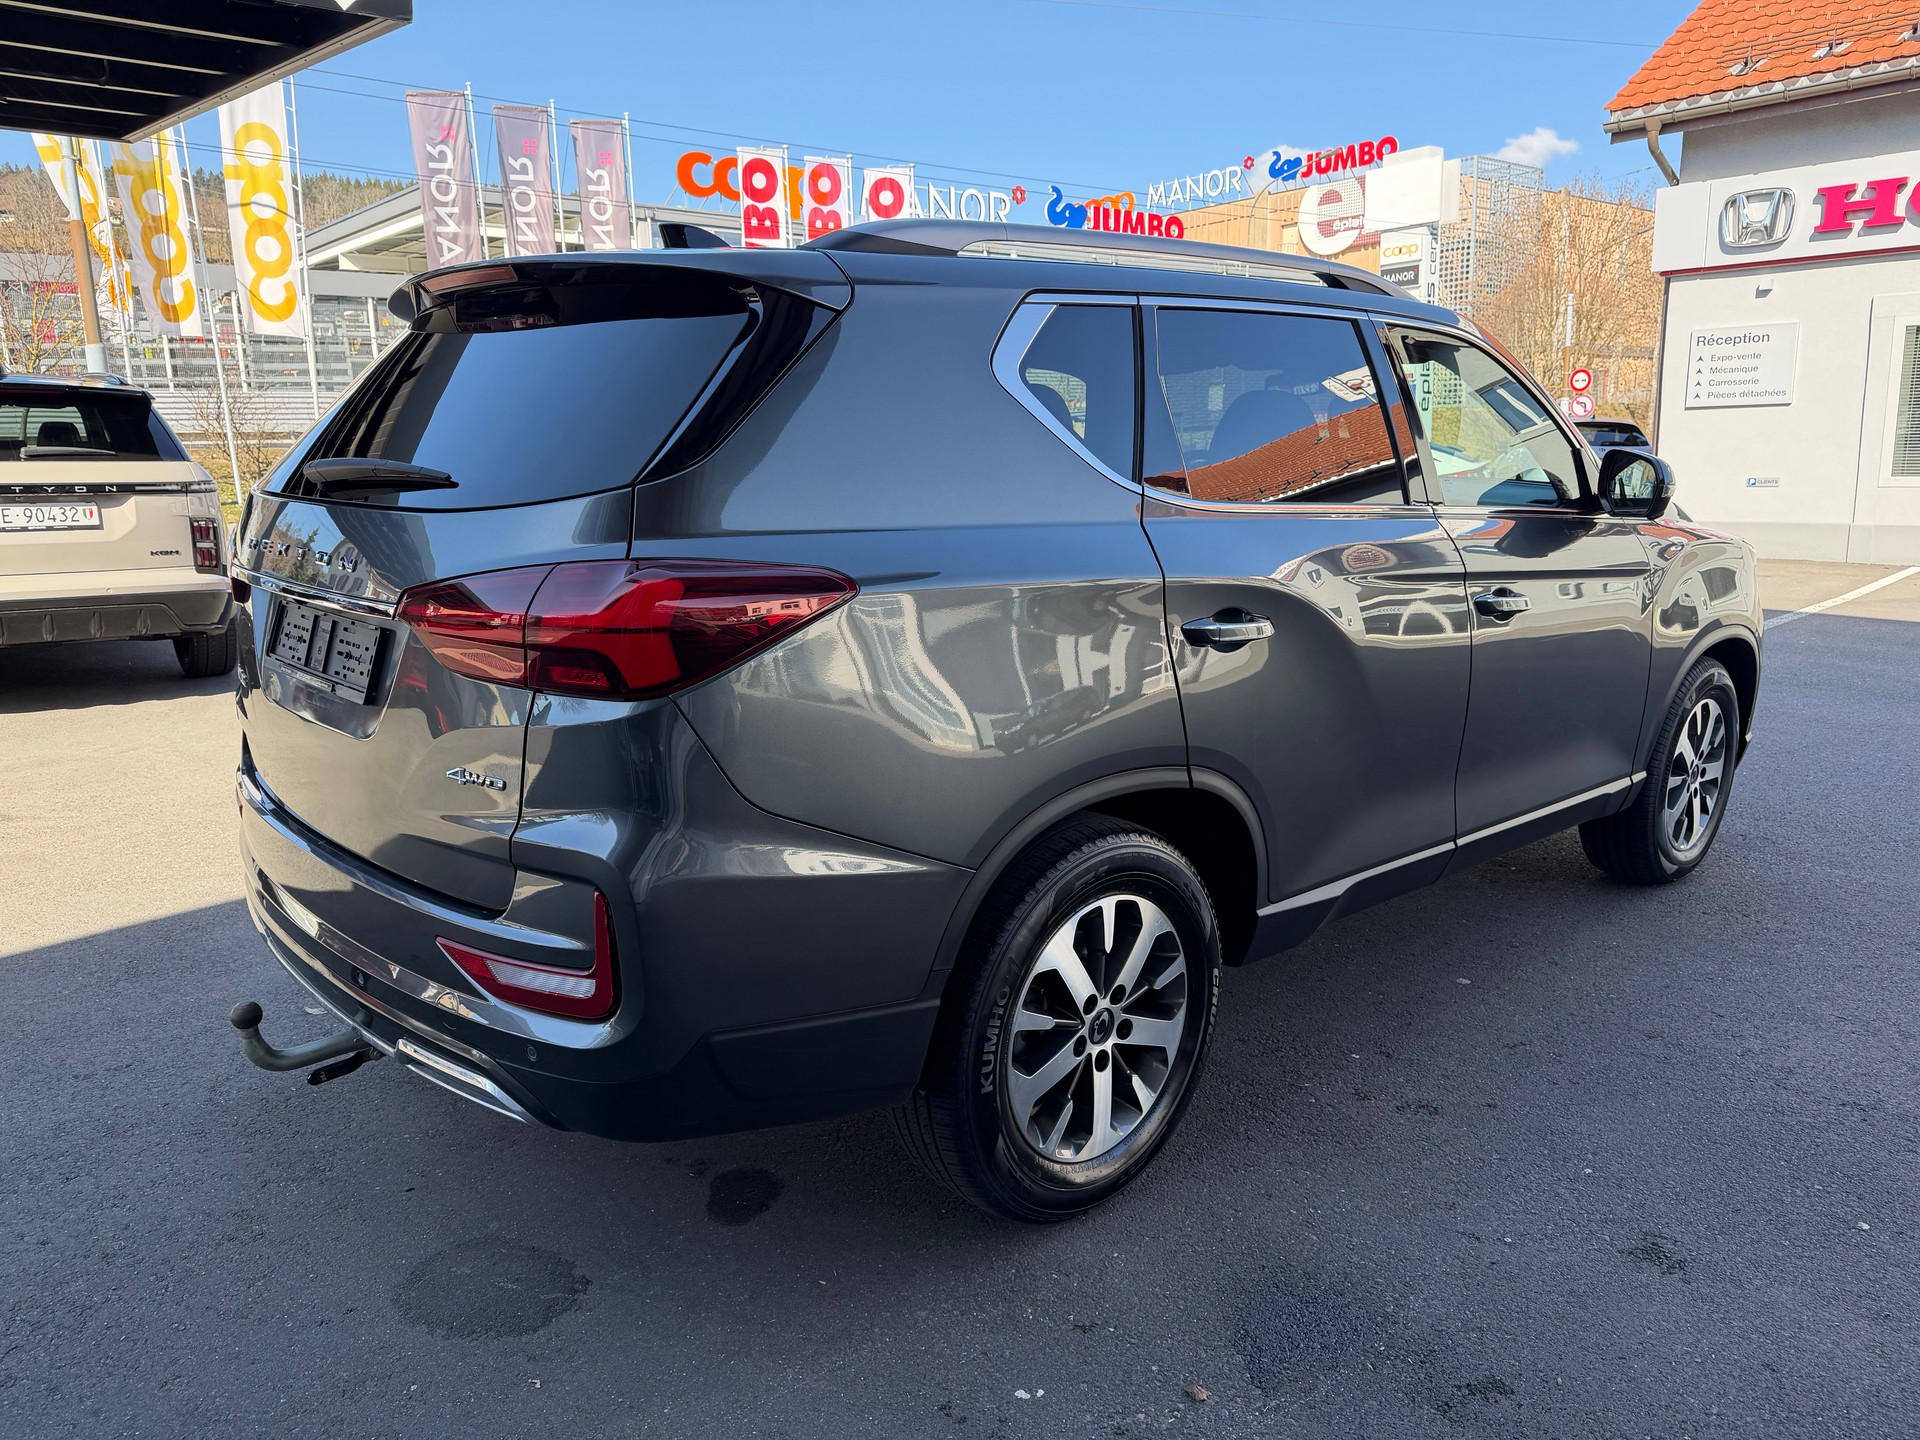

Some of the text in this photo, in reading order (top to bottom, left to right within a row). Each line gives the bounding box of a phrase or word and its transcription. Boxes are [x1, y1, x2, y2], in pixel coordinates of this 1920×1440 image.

[1300, 135, 1399, 179] JUMBO
[1147, 165, 1243, 210] MANOR
[1086, 205, 1185, 240] JUMBO
[1383, 243, 1419, 258] coop
[1697, 332, 1770, 347] Réception
[1710, 352, 1762, 363] Expo-vente
[1709, 365, 1759, 375] Mécanique
[1708, 377, 1760, 387] Carrosserie
[1707, 388, 1787, 399] Pièces détachées
[980, 985, 1010, 1094] KUMHO
